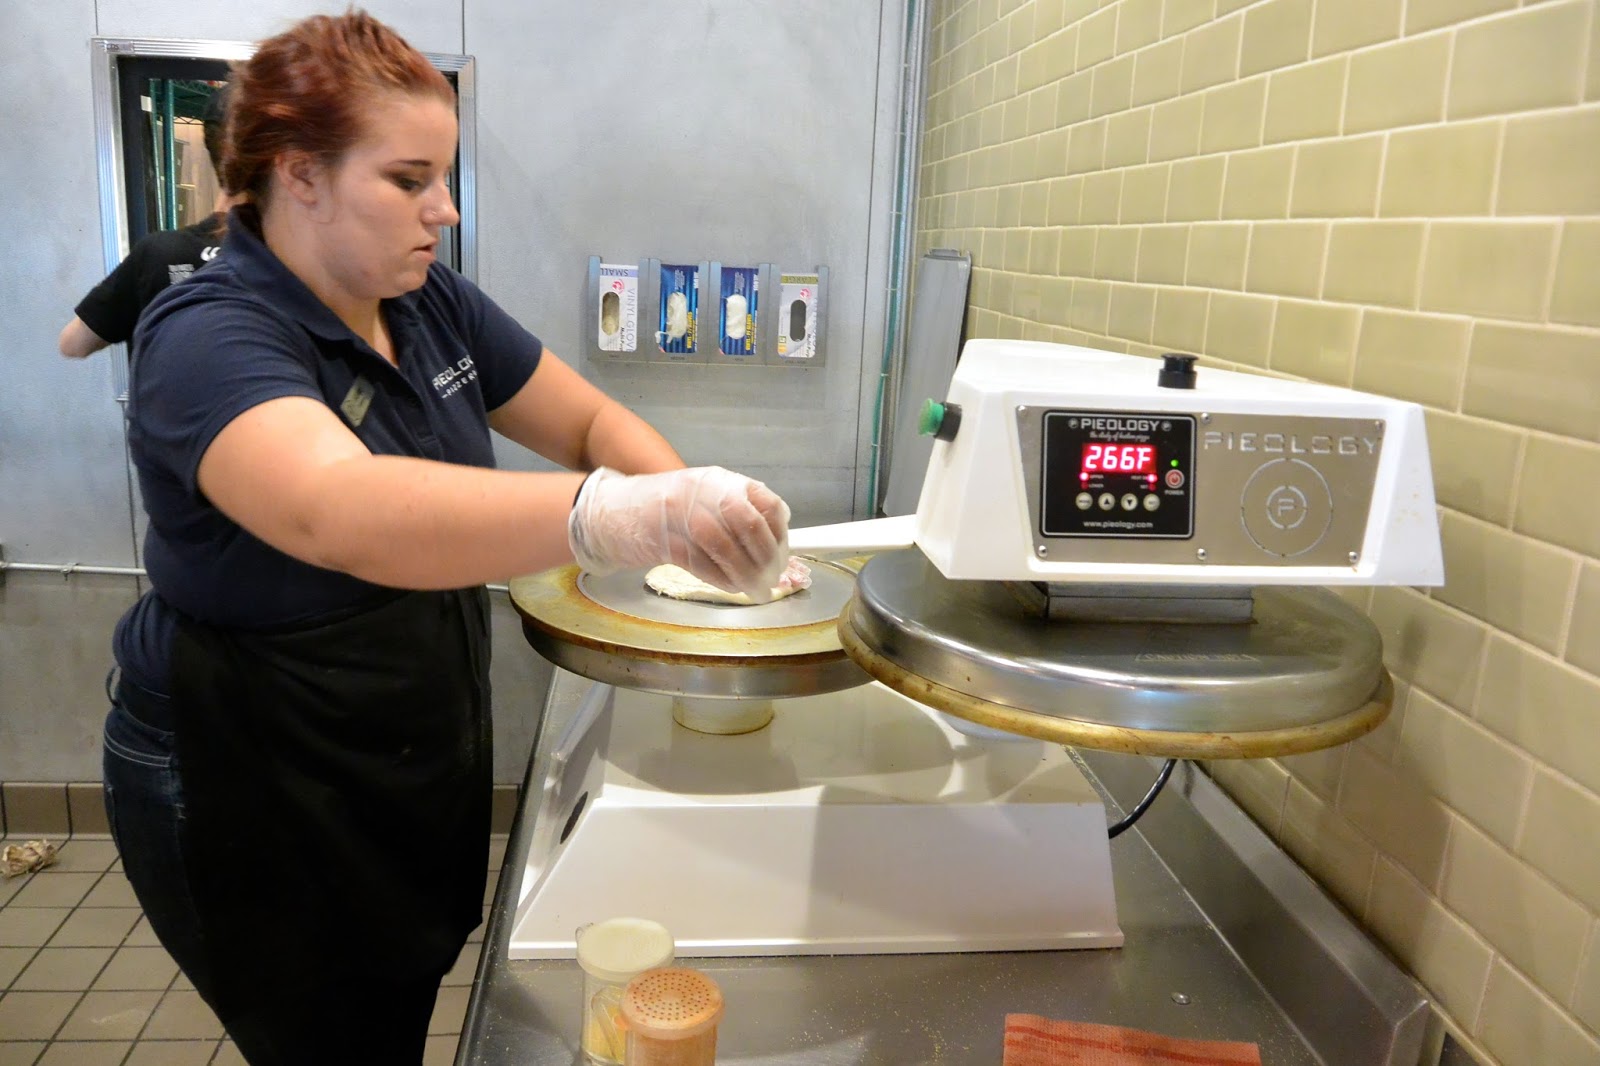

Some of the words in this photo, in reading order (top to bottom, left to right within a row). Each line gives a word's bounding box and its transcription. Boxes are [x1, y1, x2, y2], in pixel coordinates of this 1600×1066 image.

[600, 268, 629, 277] SMALL
[626, 288, 636, 318] VINYL
[1081, 418, 1160, 431] PIEOLOGY
[1204, 431, 1376, 455] PIEOLOGY
[1085, 445, 1152, 470] 266F
[1083, 521, 1154, 529] www.pieology.com
